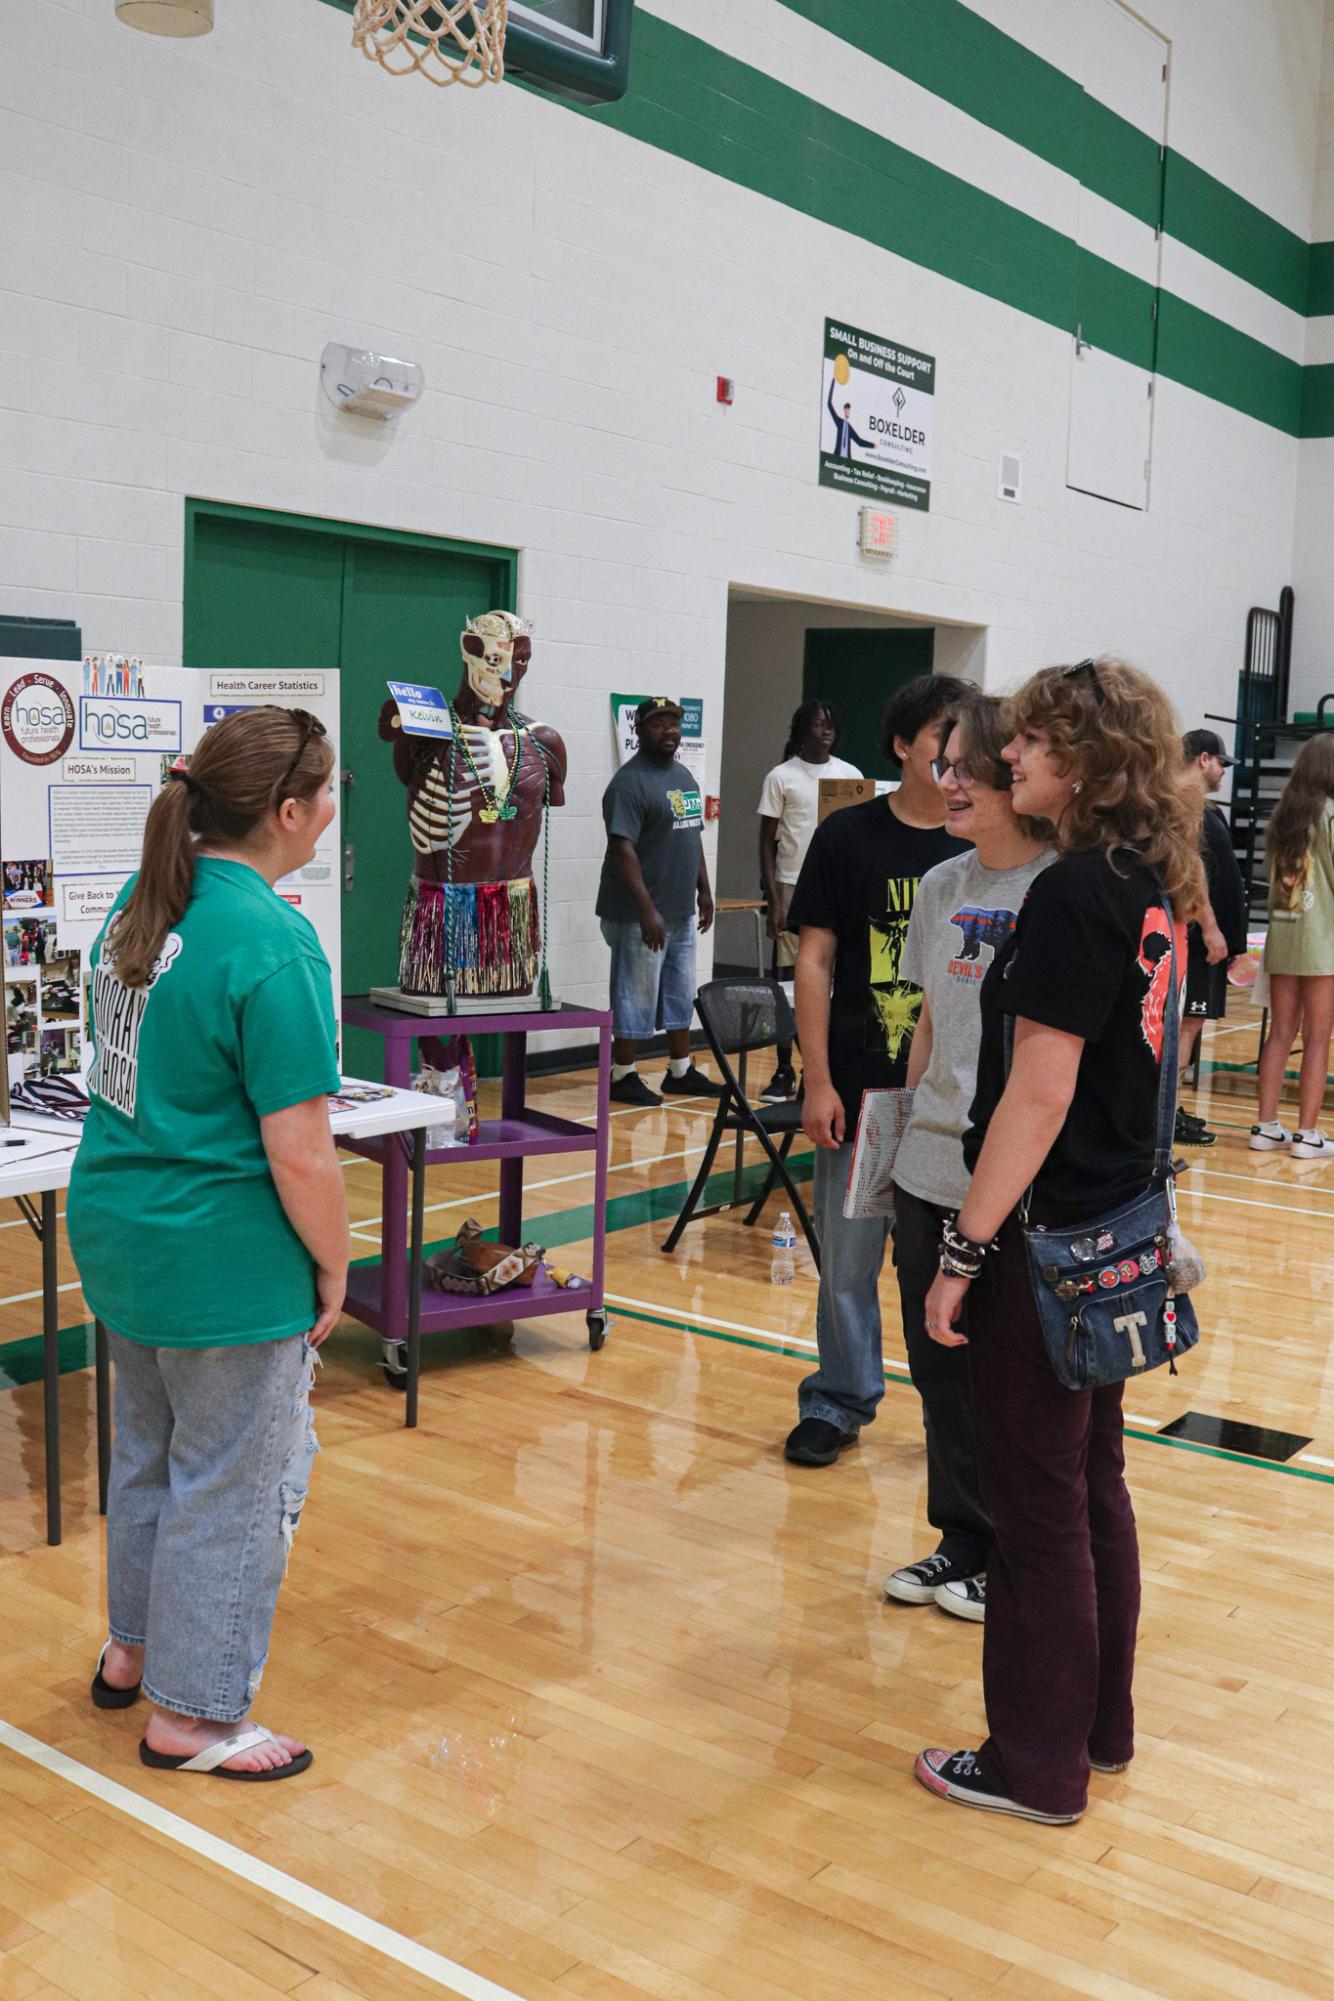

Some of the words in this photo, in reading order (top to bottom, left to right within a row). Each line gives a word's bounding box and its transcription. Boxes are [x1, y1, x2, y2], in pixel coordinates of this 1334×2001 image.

[830, 327, 857, 346] SMALL
[858, 338, 896, 360] BUSINESS
[897, 352, 932, 374] SUPPORT
[848, 348, 858, 360] On
[859, 354, 872, 364] and
[873, 356, 884, 369] Off
[884, 362, 896, 373] the
[896, 366, 915, 380] Court
[869, 416, 926, 446] BOXELDER
[9, 679, 26, 697] Lead
[217, 681, 246, 690] Health
[248, 681, 276, 690] Career
[278, 681, 318, 690] Statistics
[392, 685, 422, 699] hello
[16, 700, 66, 726] hosa
[84, 701, 148, 740] hosa
[410, 710, 442, 723] Kelvin
[68, 764, 97, 775] HOSA's
[100, 764, 131, 775] Mission
[69, 892, 86, 900] Give
[88, 890, 104, 900] Back
[80, 905, 112, 914] Commun
[948, 960, 983, 979] DEVIL'S
[95, 967, 147, 1059] HOORAY
[102, 1047, 137, 1114] HOSA!
